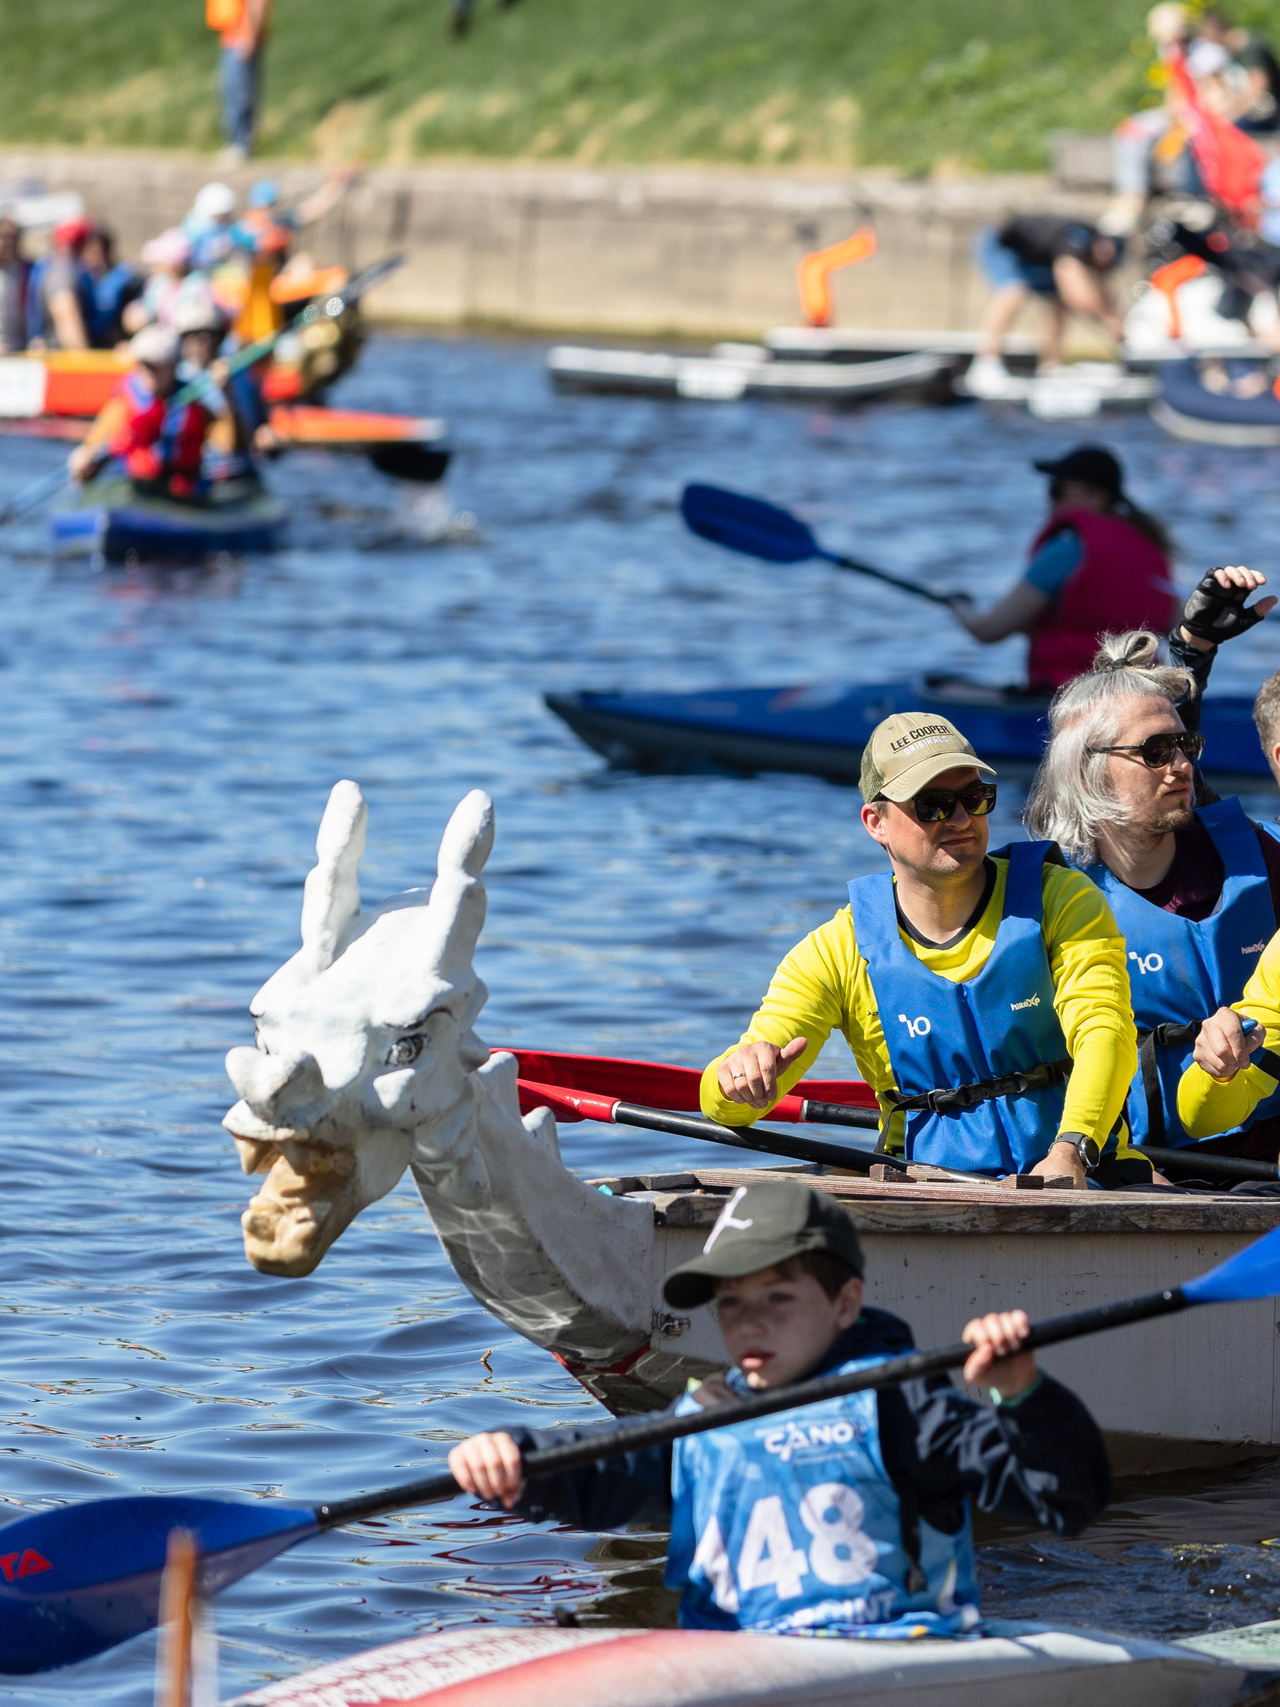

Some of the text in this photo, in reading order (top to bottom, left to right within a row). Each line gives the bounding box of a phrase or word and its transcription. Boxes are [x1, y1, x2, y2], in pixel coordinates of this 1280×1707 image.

[890, 725, 951, 751] LEE COOPER
[904, 736, 950, 755] ORIGINALS
